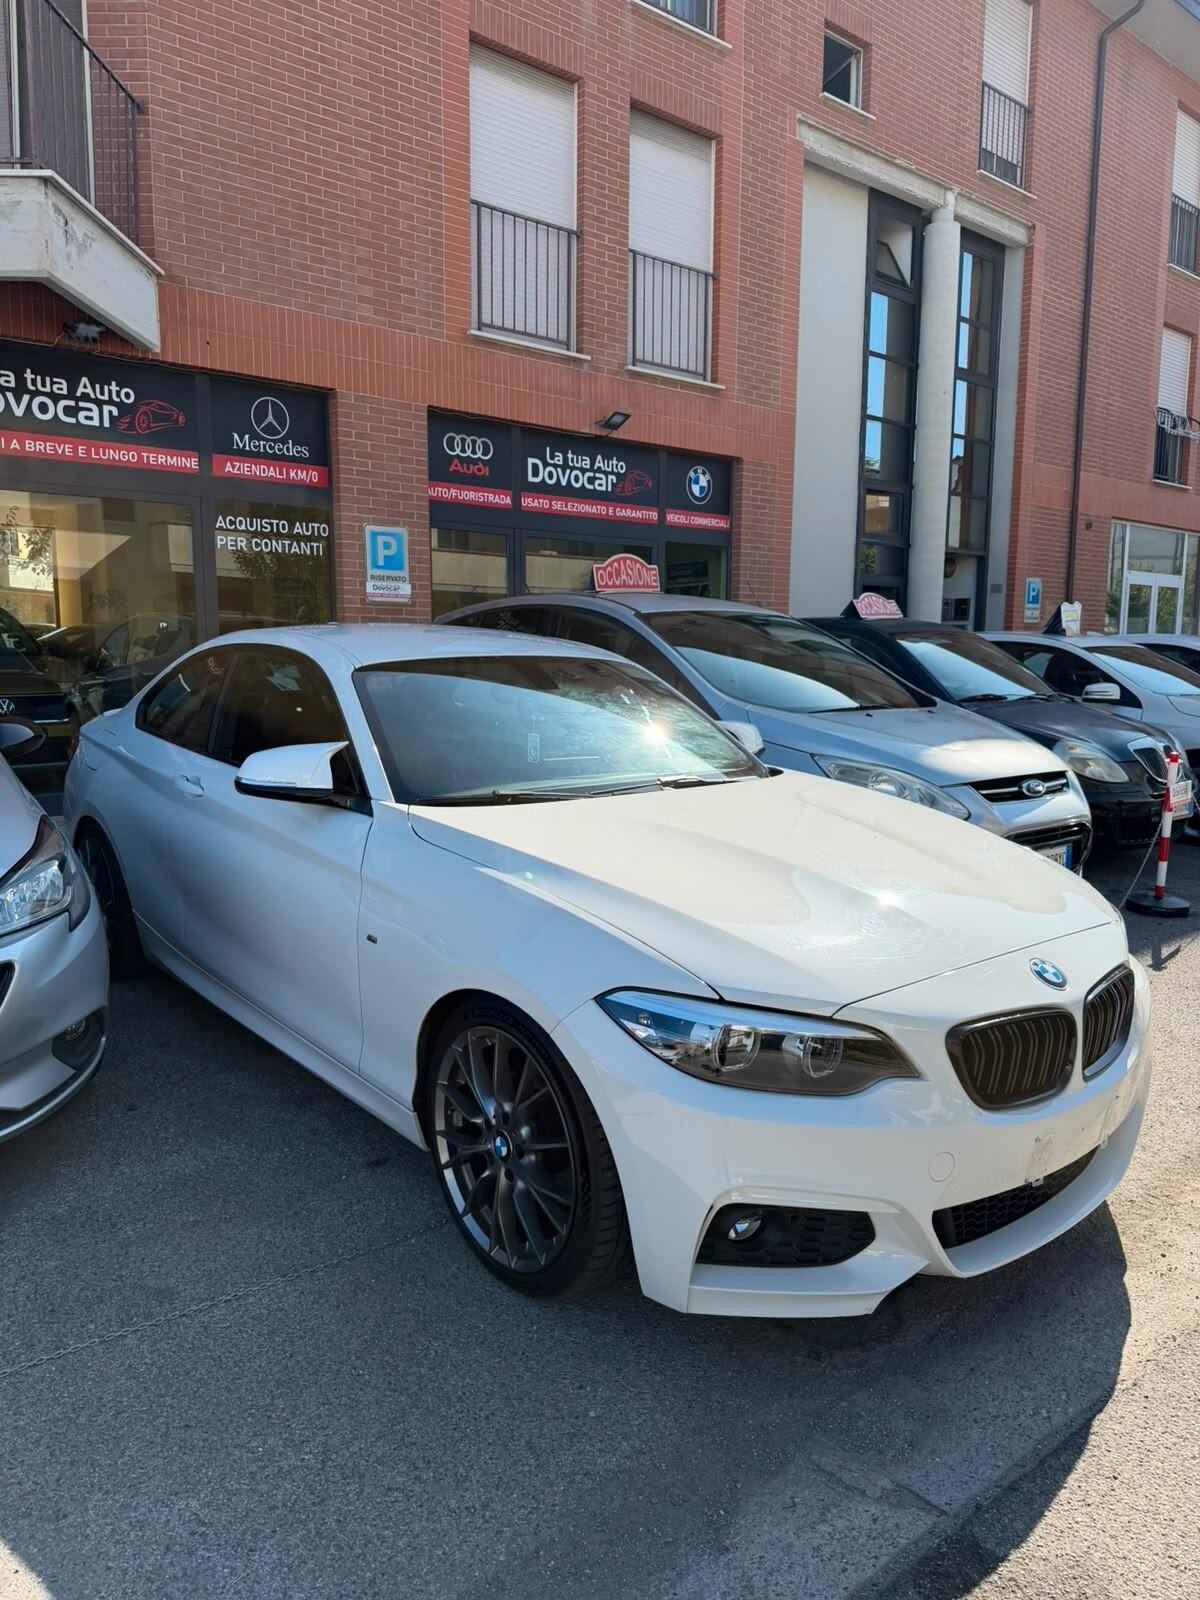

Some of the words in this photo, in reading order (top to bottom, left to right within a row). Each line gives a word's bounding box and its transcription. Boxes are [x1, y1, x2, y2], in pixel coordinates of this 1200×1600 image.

[24, 368, 68, 395] tua
[76, 376, 135, 404] Auto
[10, 439, 21, 450] A
[25, 440, 74, 456] BREVE
[78, 446, 87, 457] E
[91, 447, 137, 464] LUNGO
[141, 452, 199, 469] TERMINE
[232, 432, 310, 458] Mercedes
[448, 458, 490, 476] Audi
[546, 446, 563, 465] La
[567, 450, 591, 469] tua
[594, 454, 626, 473] Auto
[224, 461, 287, 479] AZIENDALI
[289, 468, 318, 483] KM/0
[527, 457, 617, 492] Dovocar
[521, 497, 550, 509] USATO
[552, 500, 607, 515] SELEZIONATO
[609, 507, 614, 516] E
[615, 507, 658, 520] GARANTITO
[666, 513, 690, 524] VEICOLI
[215, 515, 289, 535] ACQUISTO
[293, 522, 329, 537] AUTO
[217, 535, 248, 551] PER
[251, 538, 323, 556] CONTANTI
[376, 535, 397, 566] P
[370, 574, 407, 583] RISERVATO
[597, 559, 657, 586] OCCASIONE
[1029, 583, 1037, 602] P
